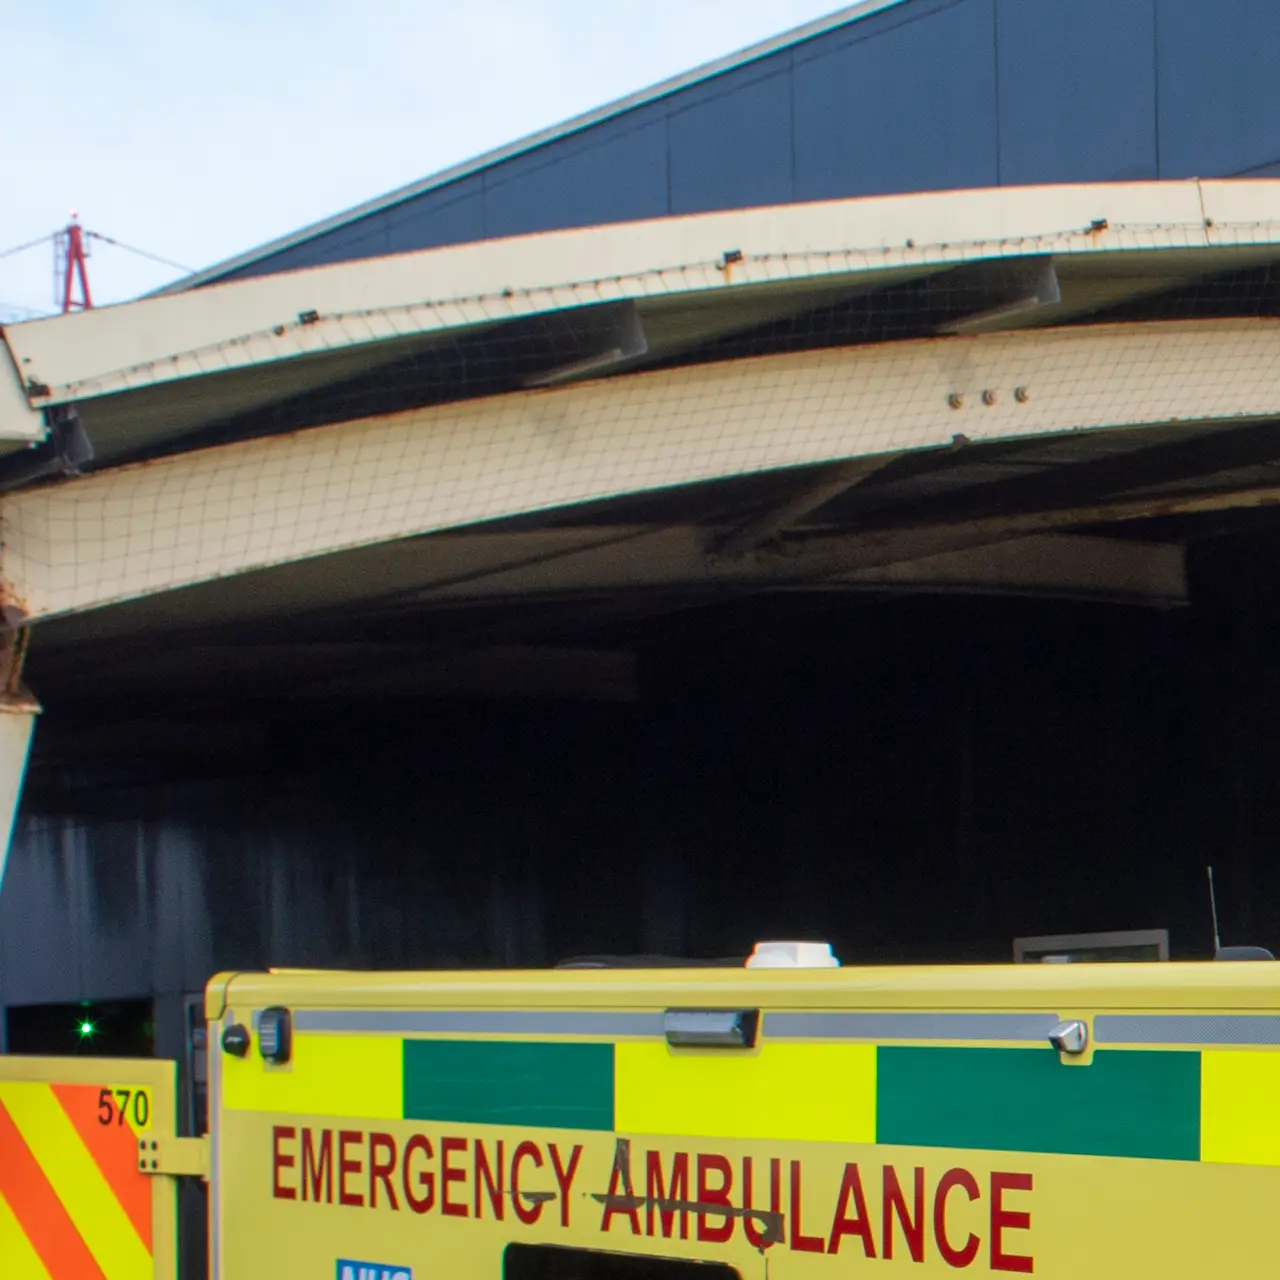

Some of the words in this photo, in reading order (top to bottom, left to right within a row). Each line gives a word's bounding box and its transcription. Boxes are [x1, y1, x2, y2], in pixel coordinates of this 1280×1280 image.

[97, 1088, 149, 1128] 570
[272, 1125, 583, 1228] EMERGENCY
[599, 1138, 1035, 1274] AMBULANCE
